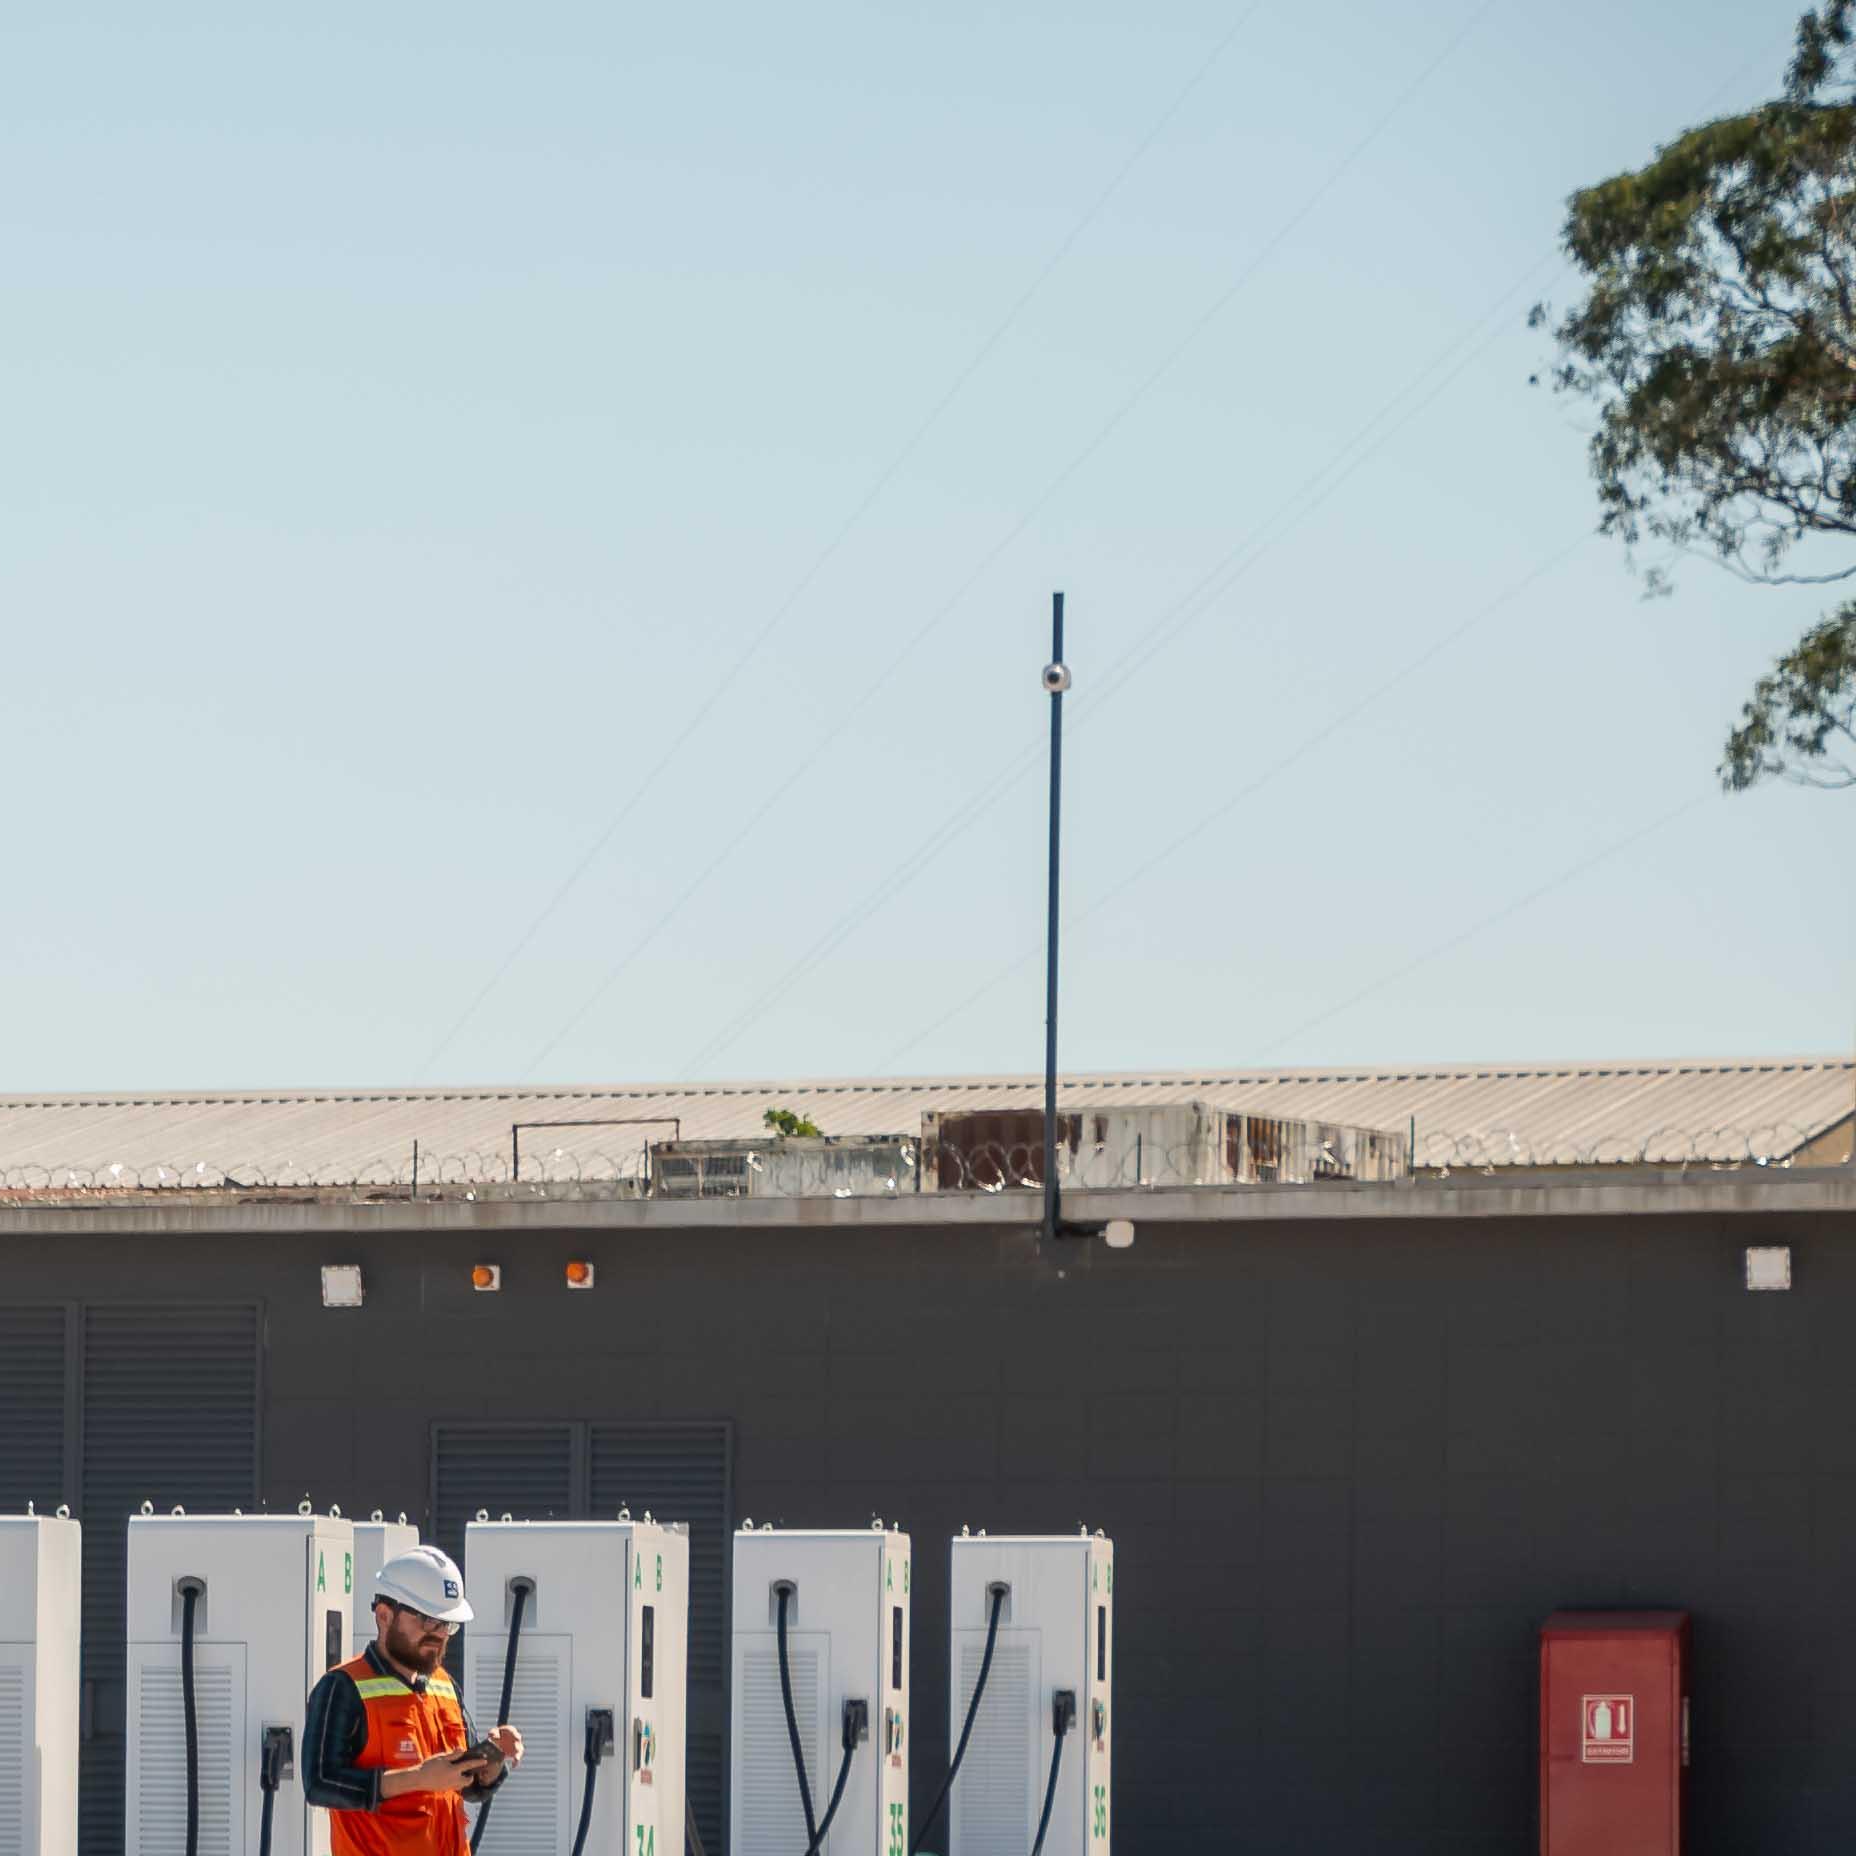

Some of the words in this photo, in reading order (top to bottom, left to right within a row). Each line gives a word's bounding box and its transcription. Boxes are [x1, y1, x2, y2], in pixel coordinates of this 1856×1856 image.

[317, 1551, 325, 1592] A
[344, 1553, 352, 1594] B
[634, 1553, 642, 1591] A
[656, 1555, 663, 1592] B
[887, 1559, 893, 1592] A
